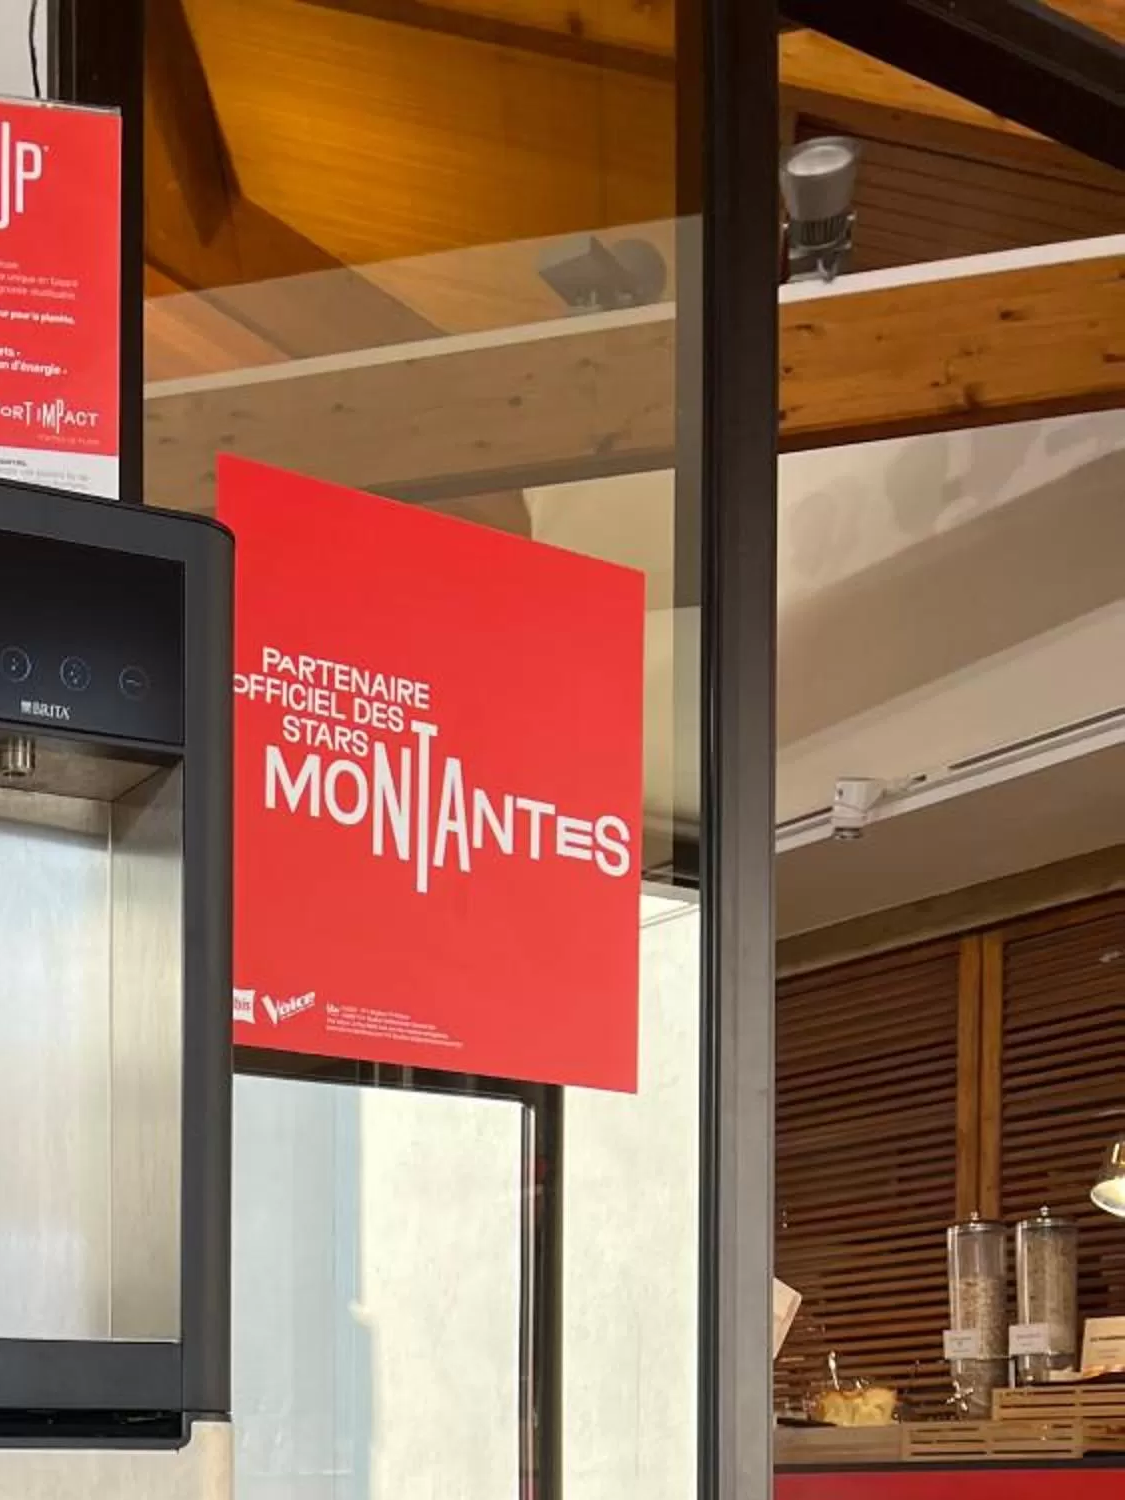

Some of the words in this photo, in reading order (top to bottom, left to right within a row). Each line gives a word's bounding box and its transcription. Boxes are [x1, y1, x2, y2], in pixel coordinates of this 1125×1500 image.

[37, 398, 99, 435] IMPACT
[233, 672, 346, 721] OFFICIEL
[353, 697, 404, 733] DES
[262, 646, 430, 710] PARTENAIRE
[32, 701, 71, 720] BRITA
[282, 714, 369, 757] STARS
[264, 720, 631, 894] MONTANTES
